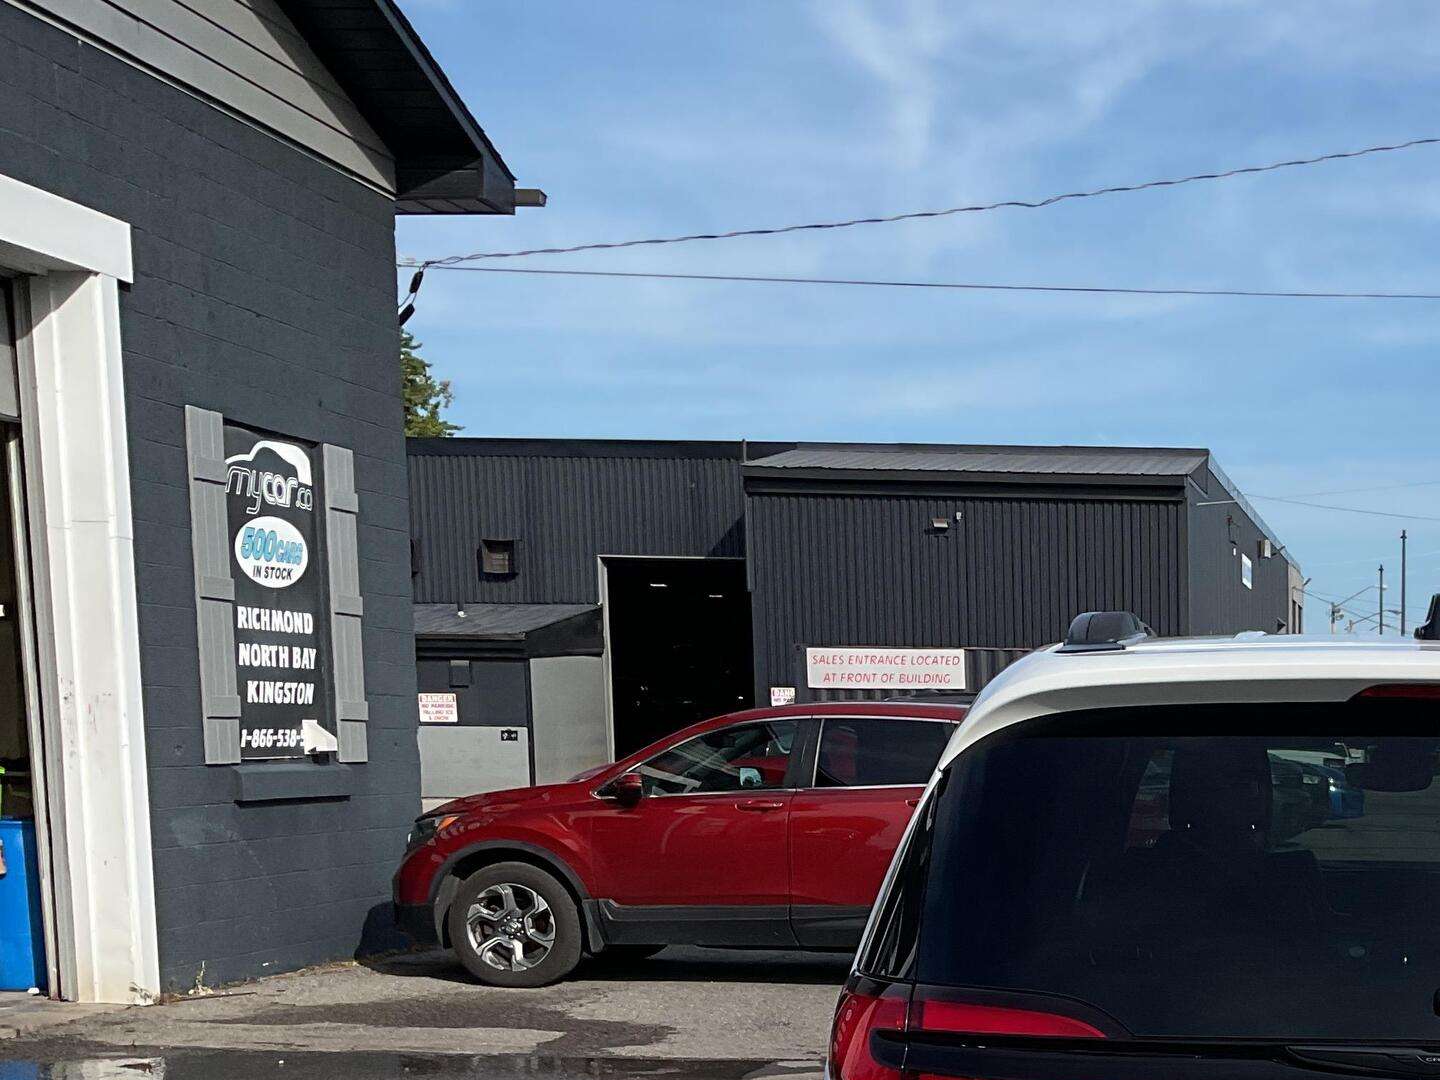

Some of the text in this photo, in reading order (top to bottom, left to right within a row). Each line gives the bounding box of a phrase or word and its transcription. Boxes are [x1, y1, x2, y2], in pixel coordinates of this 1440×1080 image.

[241, 527, 303, 565] 500 CARS
[253, 565, 293, 580] IN STOCK
[237, 605, 314, 635] RICHMOND
[238, 643, 317, 670] NORTH BAY
[812, 654, 960, 666] SALES ENTRANCE LOCATED
[823, 672, 951, 684] AT FRONT OF BUILDING
[247, 680, 315, 704] KINGSTON
